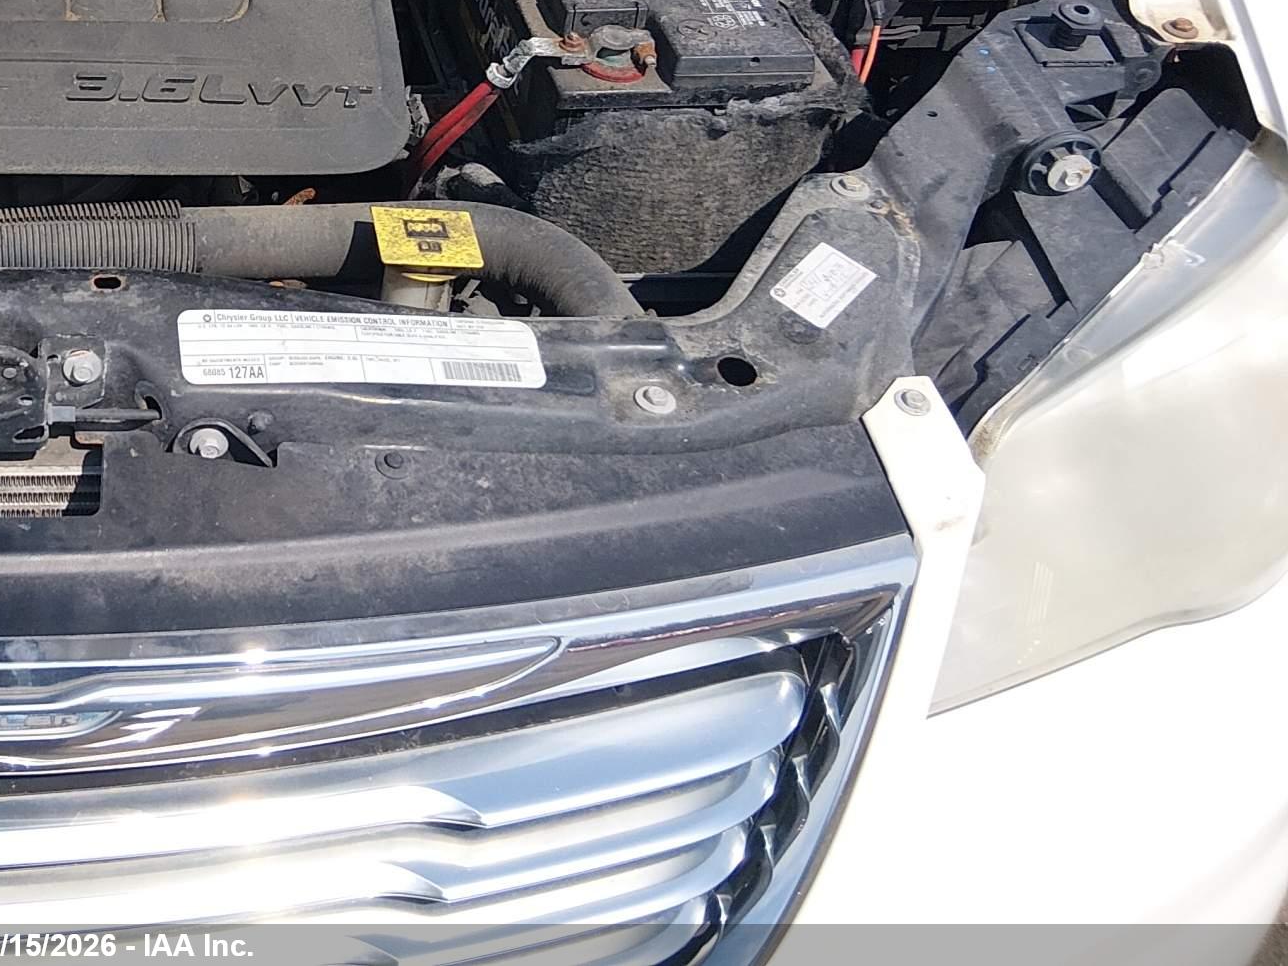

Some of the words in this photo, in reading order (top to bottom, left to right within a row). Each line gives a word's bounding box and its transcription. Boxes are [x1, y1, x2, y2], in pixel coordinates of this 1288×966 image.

[216, 313, 248, 324] Chrysler
[249, 313, 272, 324] Group
[274, 314, 289, 323] LLC
[294, 314, 325, 324] VEHICLE
[326, 314, 362, 325] EMISSION
[363, 316, 396, 326] CONTROL
[398, 317, 449, 328] INFORMATION
[228, 365, 265, 380] 127AA
